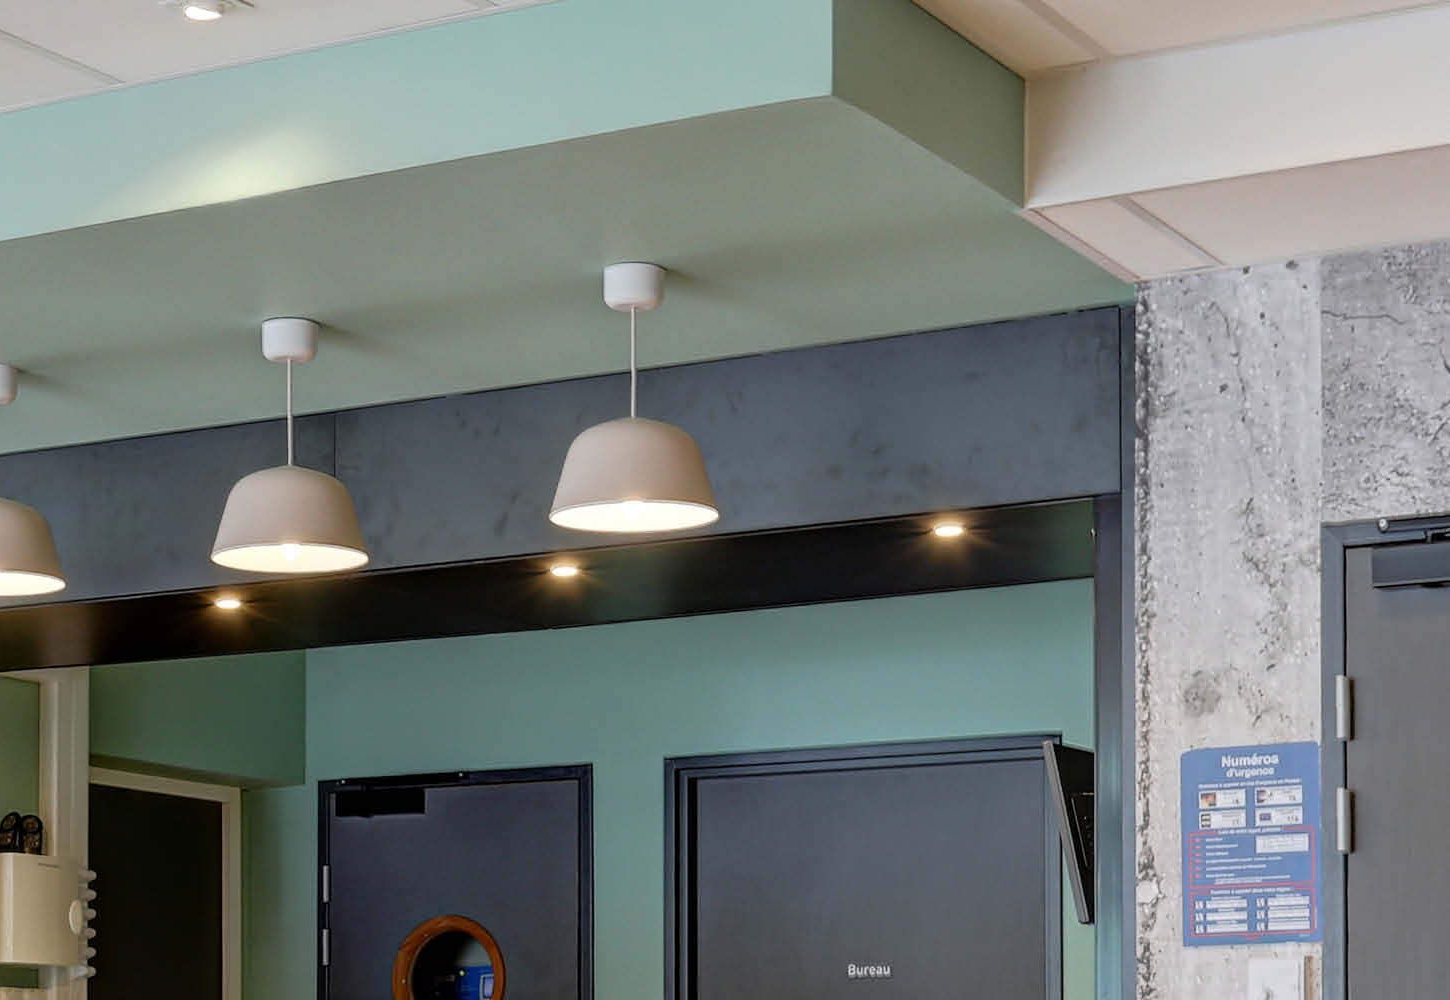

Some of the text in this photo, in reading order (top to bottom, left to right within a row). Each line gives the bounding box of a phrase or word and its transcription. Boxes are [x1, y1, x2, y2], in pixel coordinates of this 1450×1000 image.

[1221, 753, 1279, 768] Numéros
[1226, 767, 1275, 778] d'urgence
[848, 963, 891, 977] Bureau
